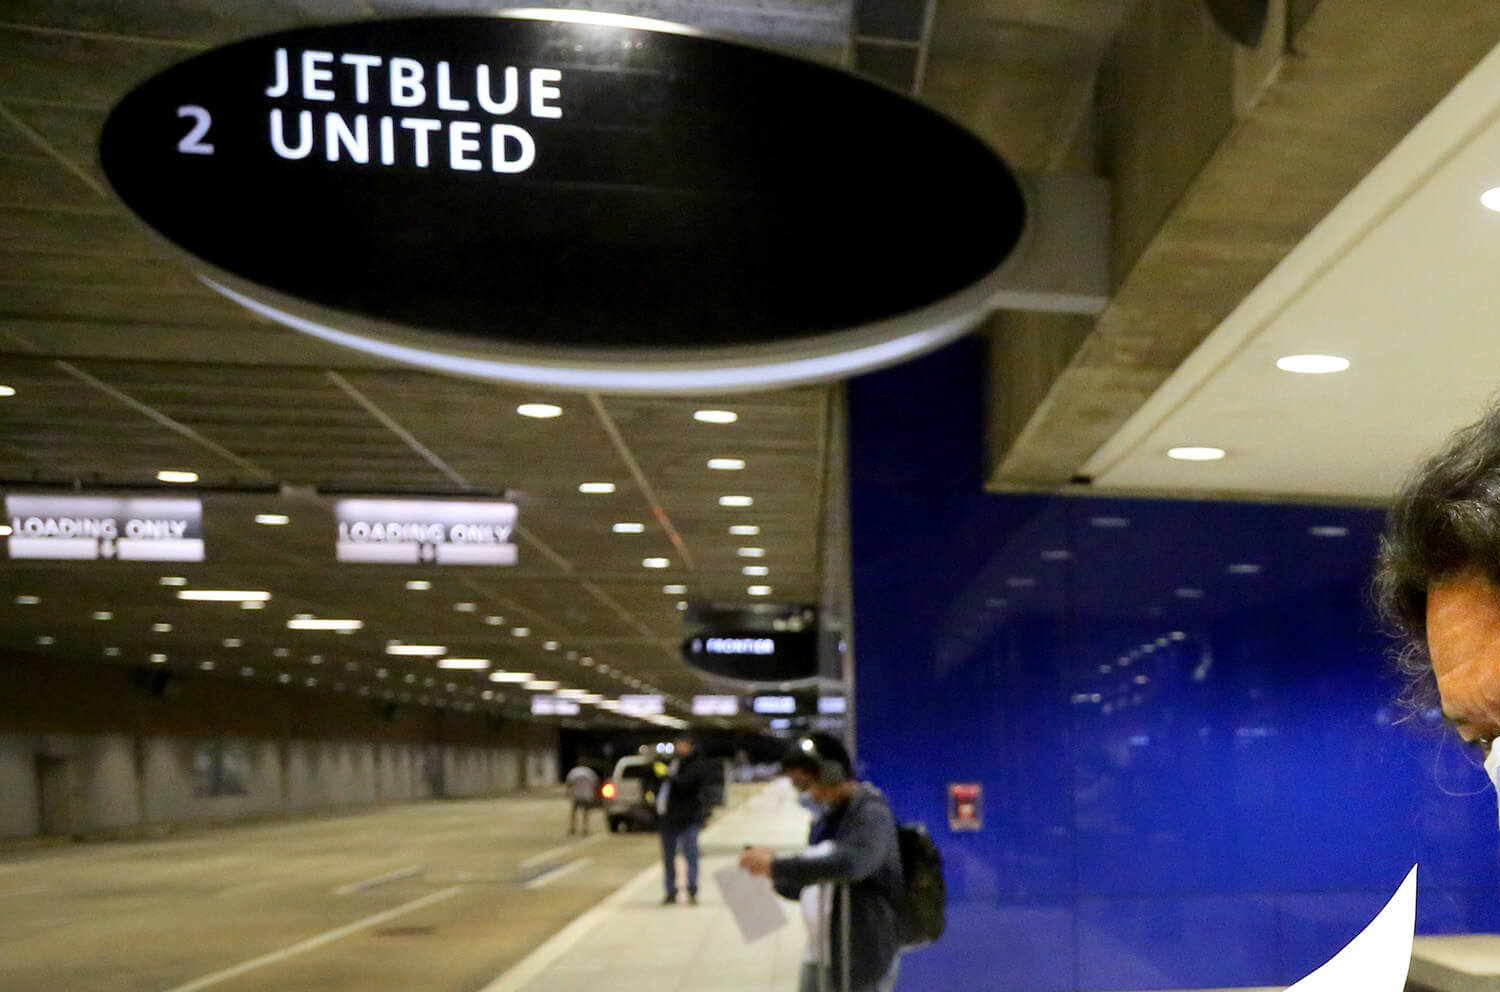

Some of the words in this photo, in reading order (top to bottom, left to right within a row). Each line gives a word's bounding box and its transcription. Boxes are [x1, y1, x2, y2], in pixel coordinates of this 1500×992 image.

[266, 48, 563, 120] JETBLUE
[177, 106, 214, 154] 2
[269, 111, 536, 174] UNITED
[12, 517, 118, 538] LOADING
[125, 519, 188, 537] ONLY
[339, 521, 445, 543] LOADING
[450, 524, 512, 543] ONLY
